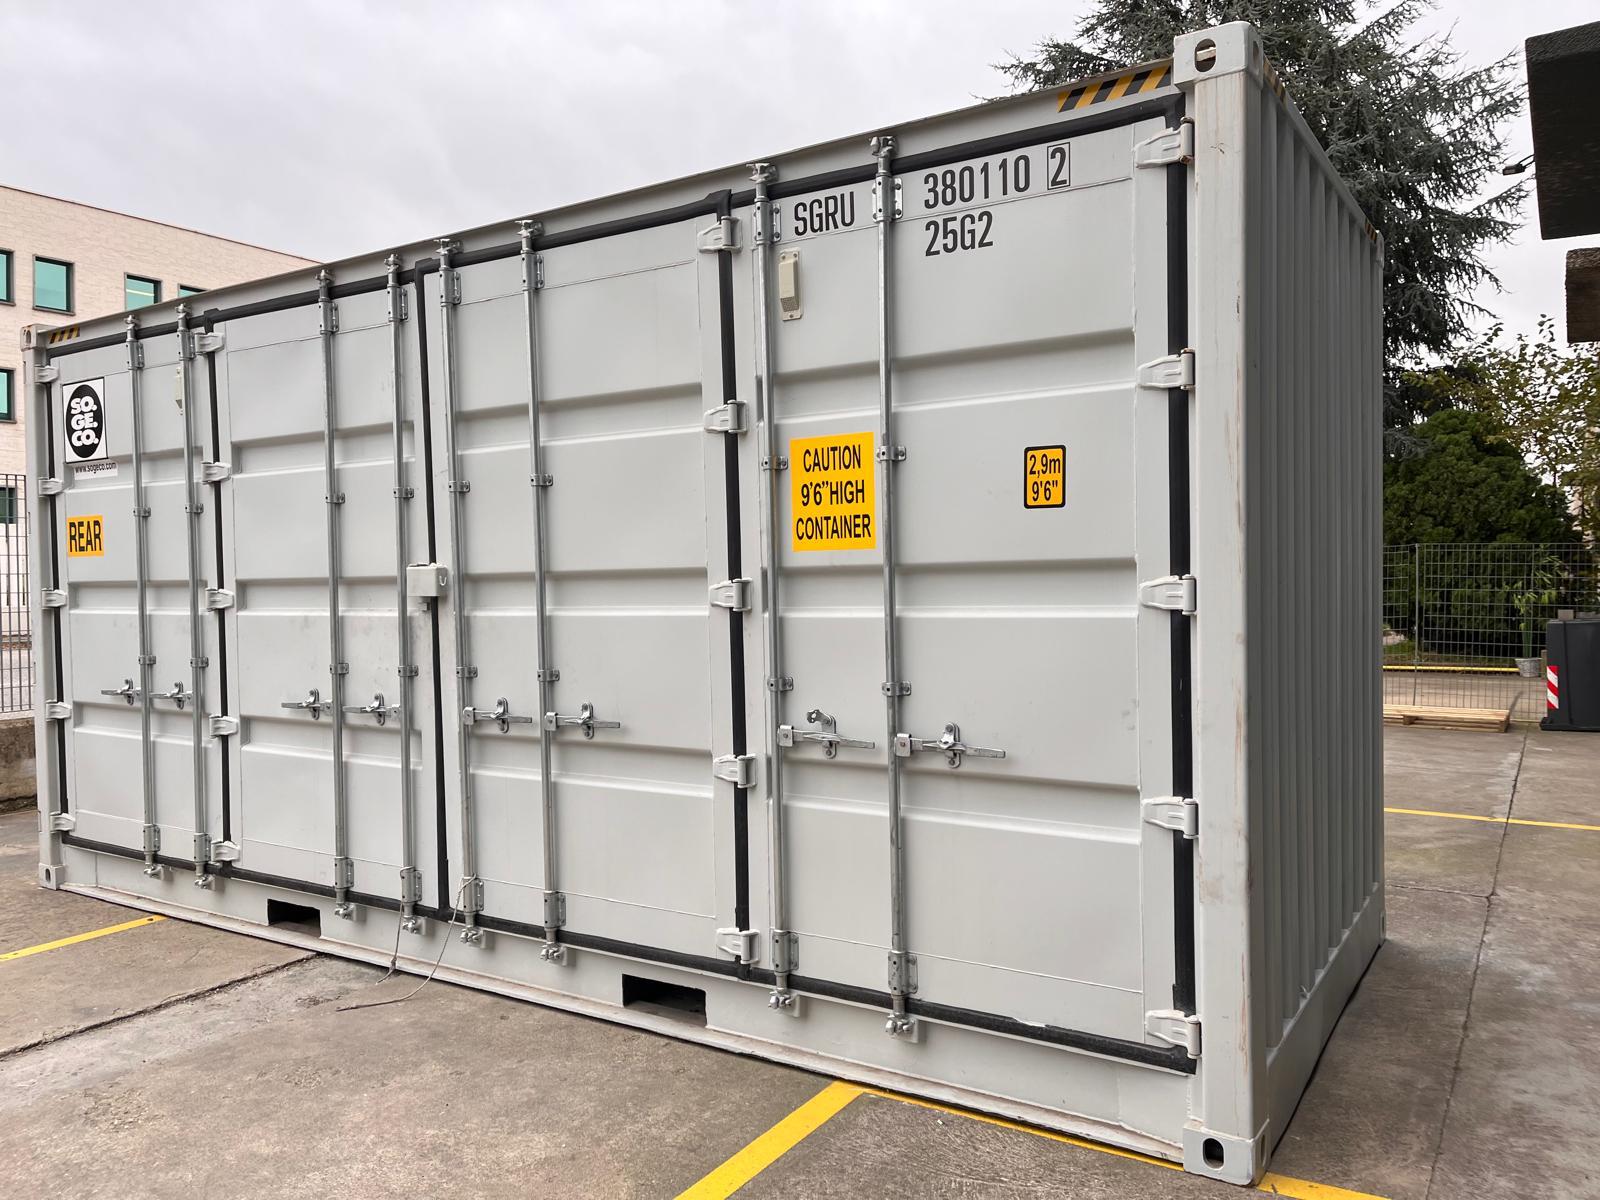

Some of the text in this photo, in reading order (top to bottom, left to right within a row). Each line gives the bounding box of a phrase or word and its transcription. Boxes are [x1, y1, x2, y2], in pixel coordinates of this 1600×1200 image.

[793, 145, 1069, 237] SGRU 380110 2
[924, 209, 994, 257] 25G2
[74, 461, 118, 475] www.sogeco.com
[802, 443, 862, 474] CAUTION
[1028, 453, 1062, 479] 2,9m
[1030, 480, 1059, 502] 9'6"
[68, 519, 102, 553] REAR
[795, 513, 872, 542] CONTAINER
